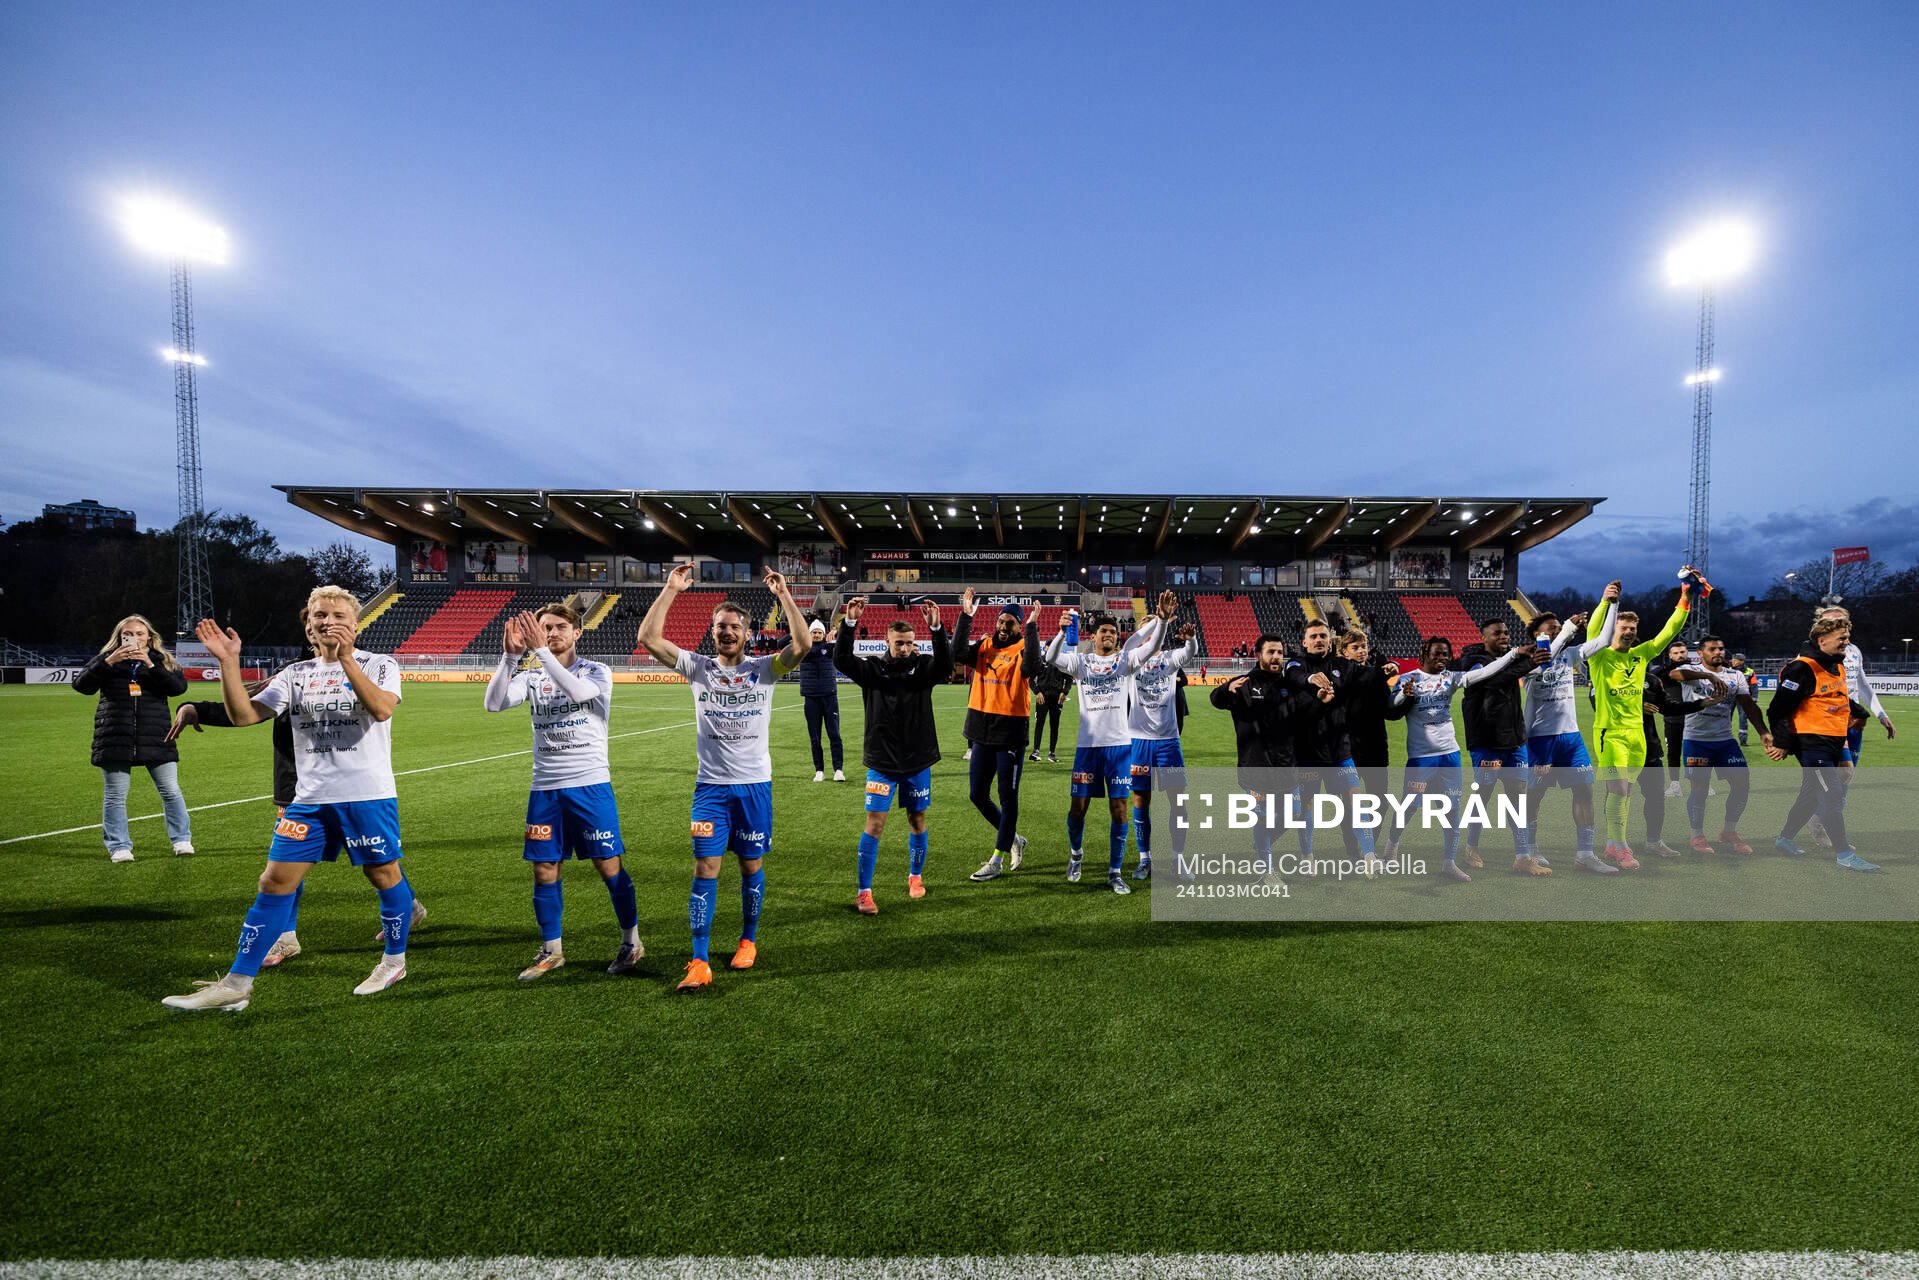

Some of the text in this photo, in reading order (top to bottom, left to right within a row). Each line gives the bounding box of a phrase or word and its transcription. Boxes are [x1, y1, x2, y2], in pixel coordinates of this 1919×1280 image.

[987, 595, 1033, 606] stadium
[703, 708, 763, 719] ZINKTEKNIK
[345, 834, 386, 849] ivika.
